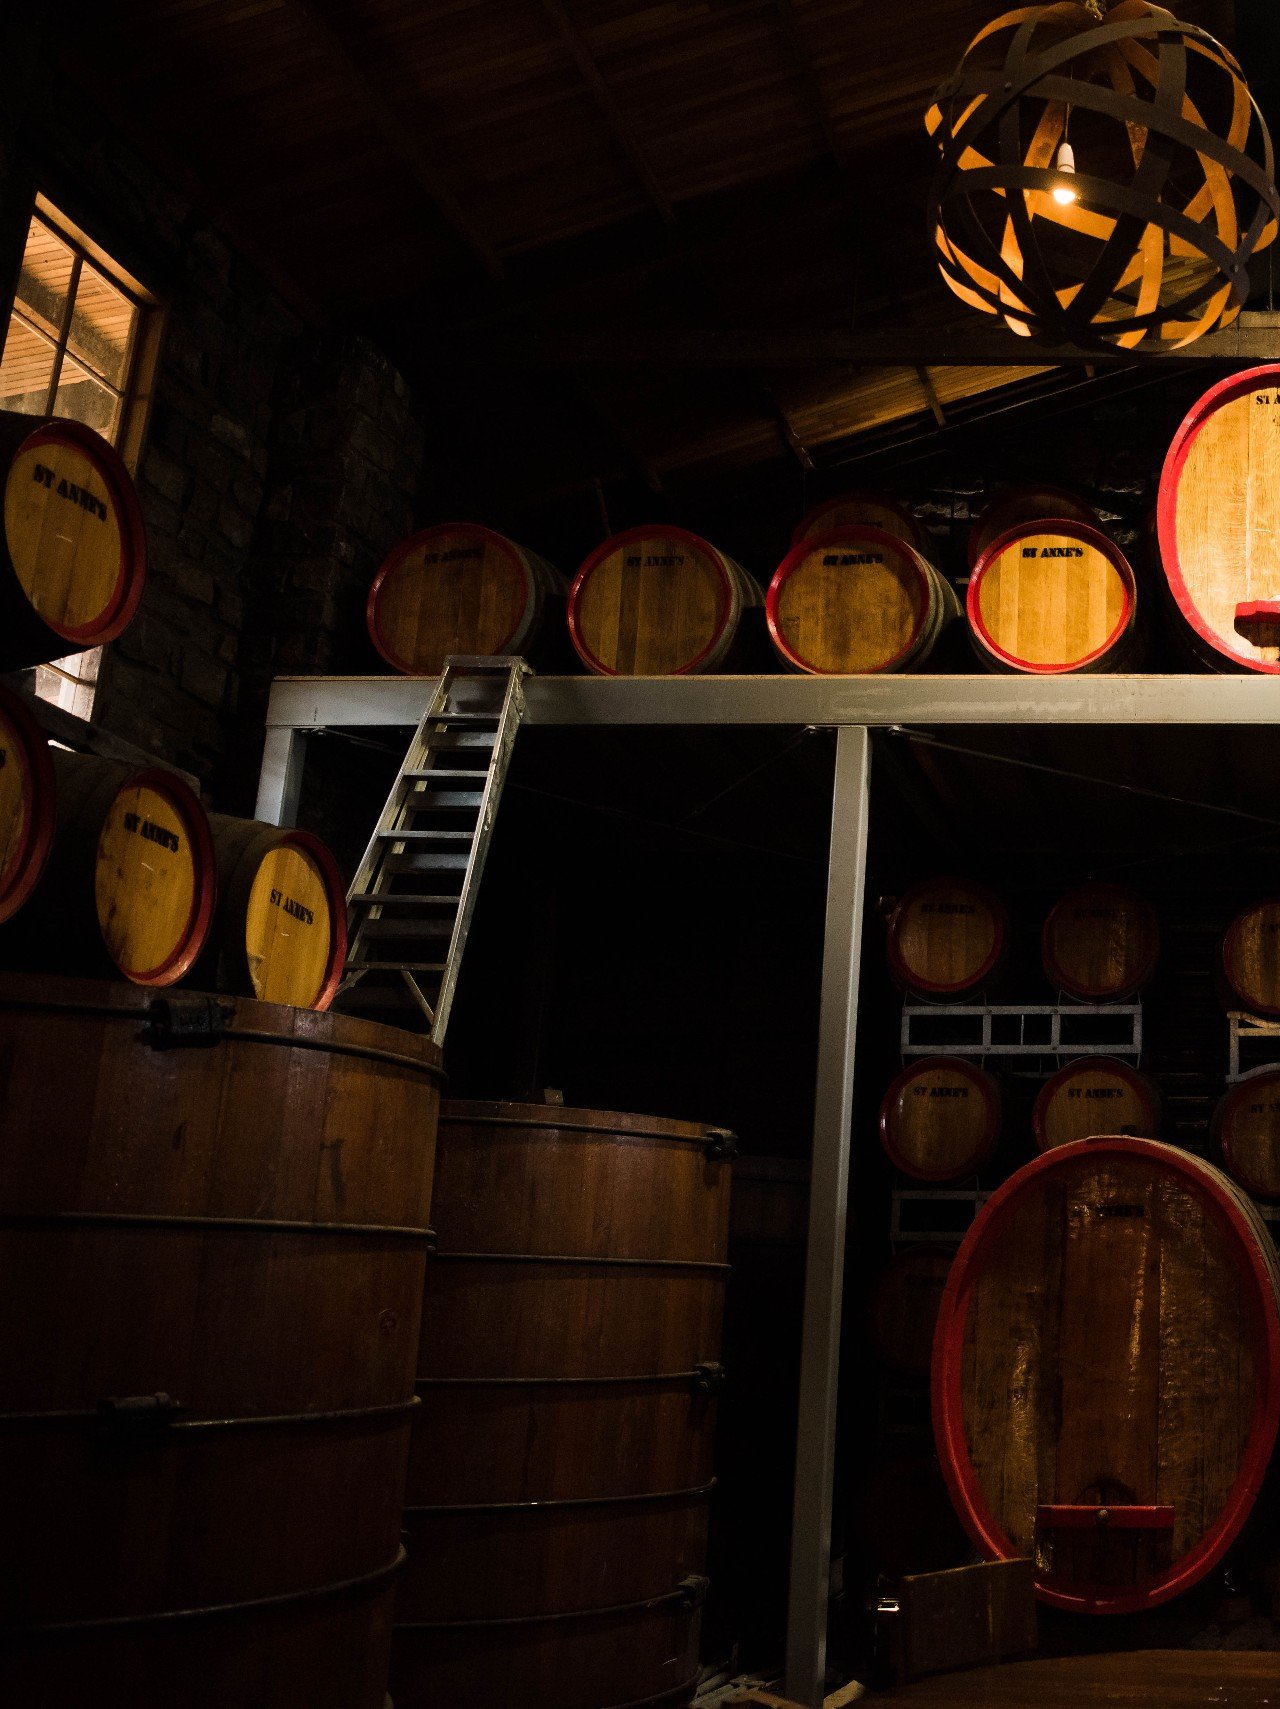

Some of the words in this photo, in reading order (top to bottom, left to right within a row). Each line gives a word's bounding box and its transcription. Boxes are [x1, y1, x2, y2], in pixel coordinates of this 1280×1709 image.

[1256, 395, 1270, 405] ST
[34, 463, 55, 489] ST
[57, 478, 107, 521] ANNE'S
[1022, 547, 1037, 558] ST
[1040, 547, 1083, 558] ANNE'S
[840, 553, 883, 566] ANNE'S
[124, 812, 141, 834] ST
[140, 820, 180, 853] ANNE'S
[269, 888, 283, 907] ST
[283, 896, 315, 926] ANNE'S
[929, 1087, 968, 1098] ANNE'S
[1085, 1088, 1123, 1099] ANNE'S
